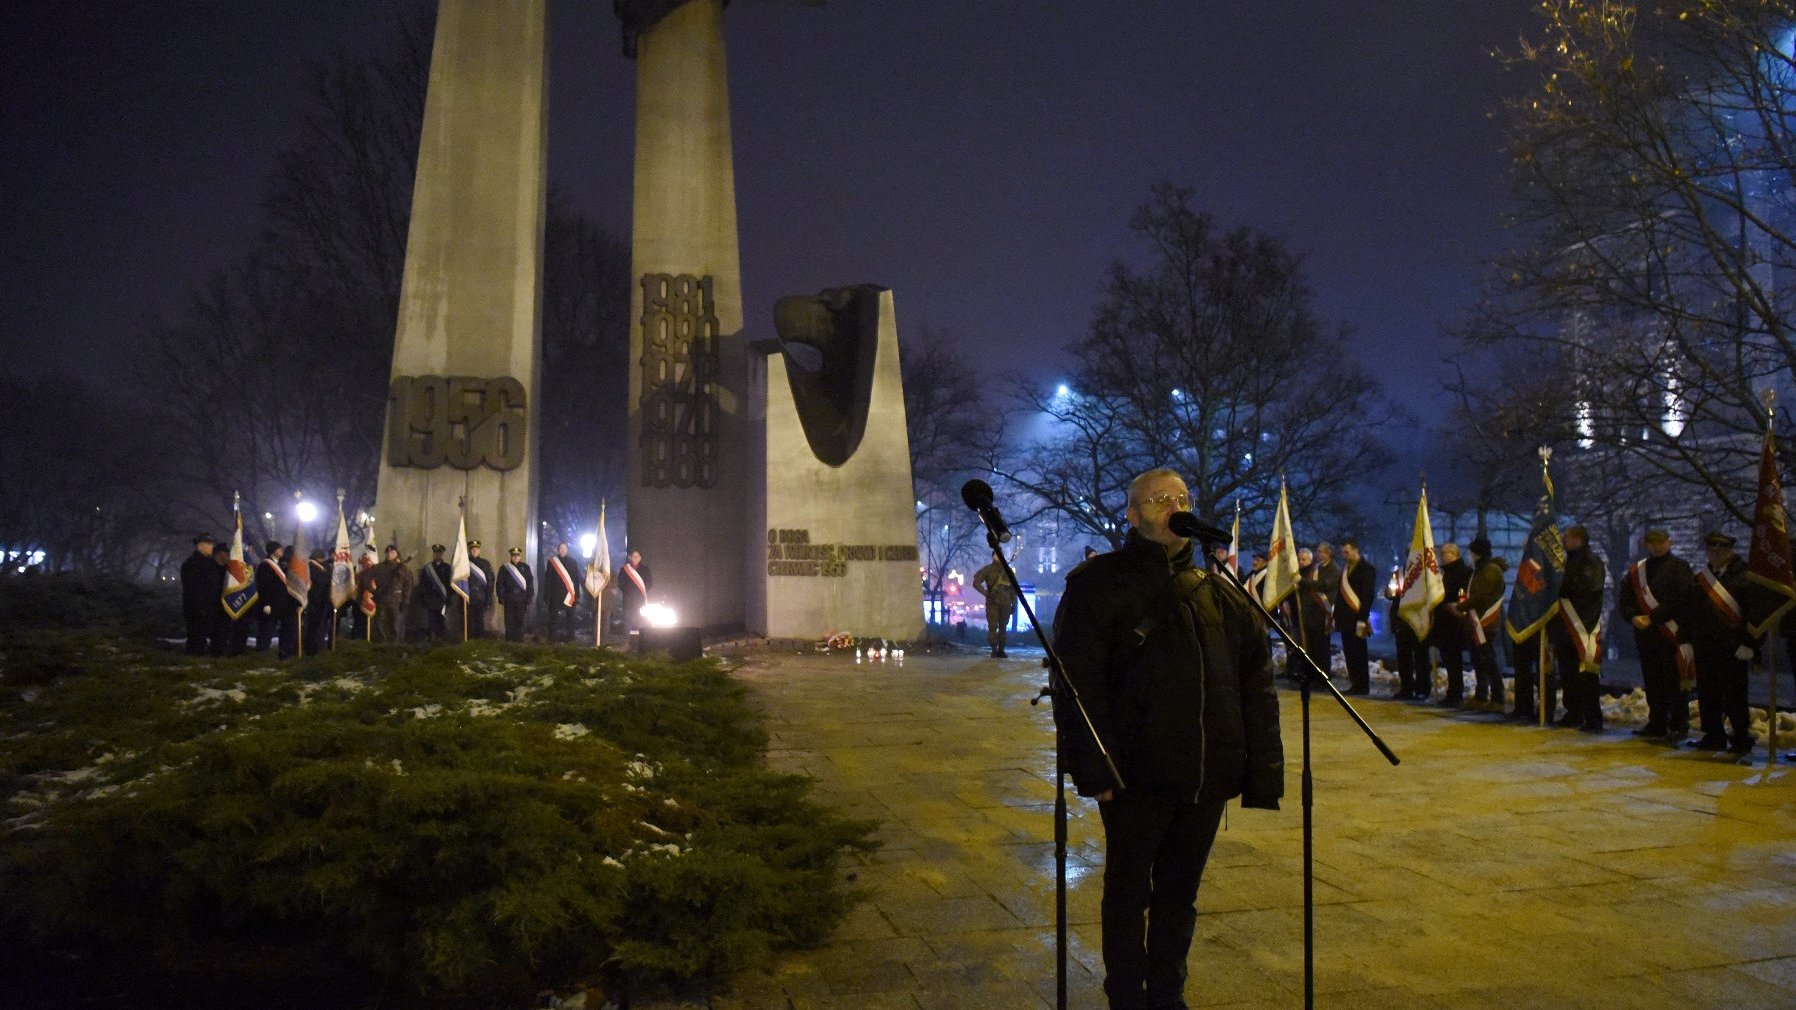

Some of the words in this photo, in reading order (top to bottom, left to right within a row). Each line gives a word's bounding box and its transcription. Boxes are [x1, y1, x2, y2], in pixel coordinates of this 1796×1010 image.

[640, 273, 714, 316] 1981
[640, 312, 719, 357] 1980
[640, 351, 720, 397] 1976
[388, 375, 526, 470] 1956
[639, 390, 720, 435] 1970
[639, 431, 720, 488] 1968
[768, 528, 777, 544] O
